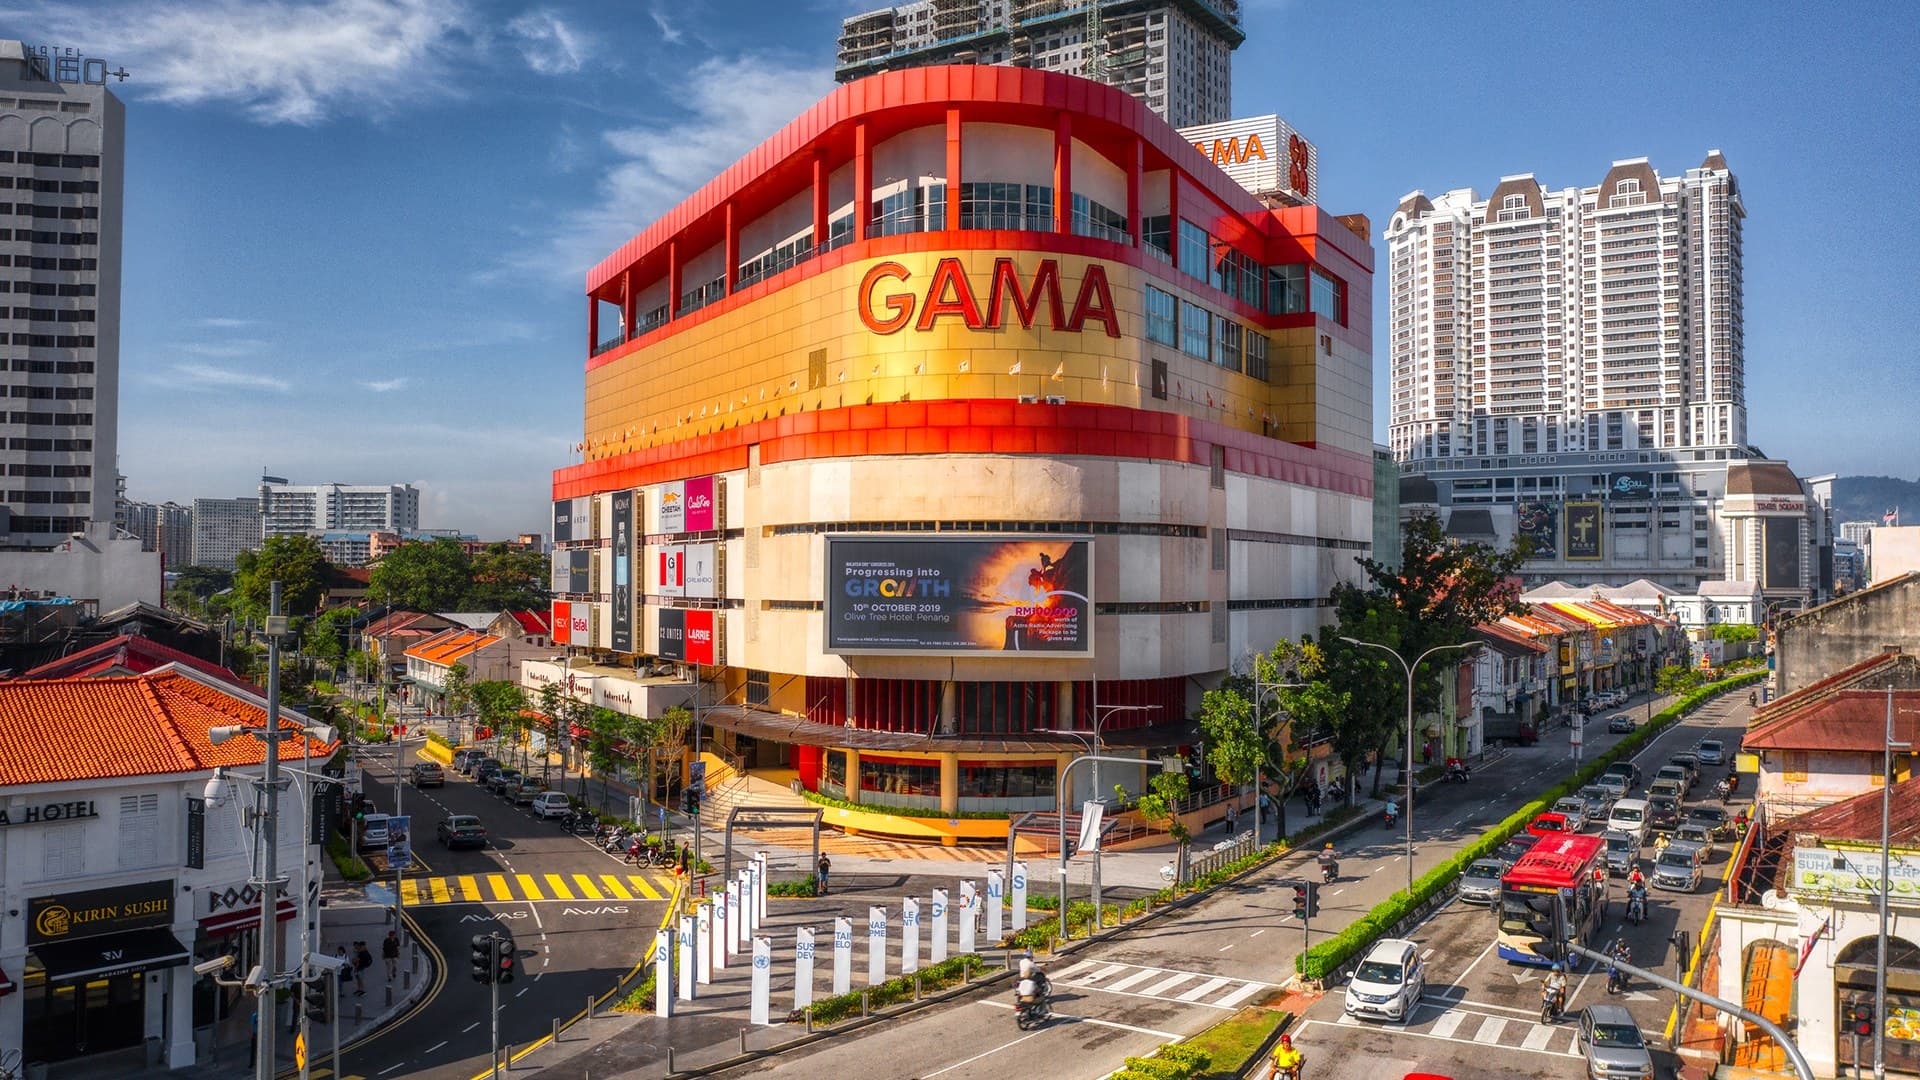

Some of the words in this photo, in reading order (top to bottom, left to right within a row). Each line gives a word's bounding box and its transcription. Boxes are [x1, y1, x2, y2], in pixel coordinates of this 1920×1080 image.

[858, 257, 1121, 338] GAMA
[846, 567, 913, 578] Progressing
[917, 567, 940, 576] into
[871, 604, 917, 612] OCTOBER
[919, 604, 941, 612] 2019
[844, 612, 866, 621] Olive
[869, 612, 888, 621] Tree
[917, 613, 950, 623] Penang
[572, 618, 588, 632] Tefal
[688, 629, 710, 640] LARRIE
[26, 800, 99, 823] HOTEL
[73, 906, 118, 924] KIRIN
[124, 899, 168, 917] SUSHI
[562, 905, 629, 916] AWAS
[460, 910, 528, 923] AWAS
[797, 942, 815, 951] SUS
